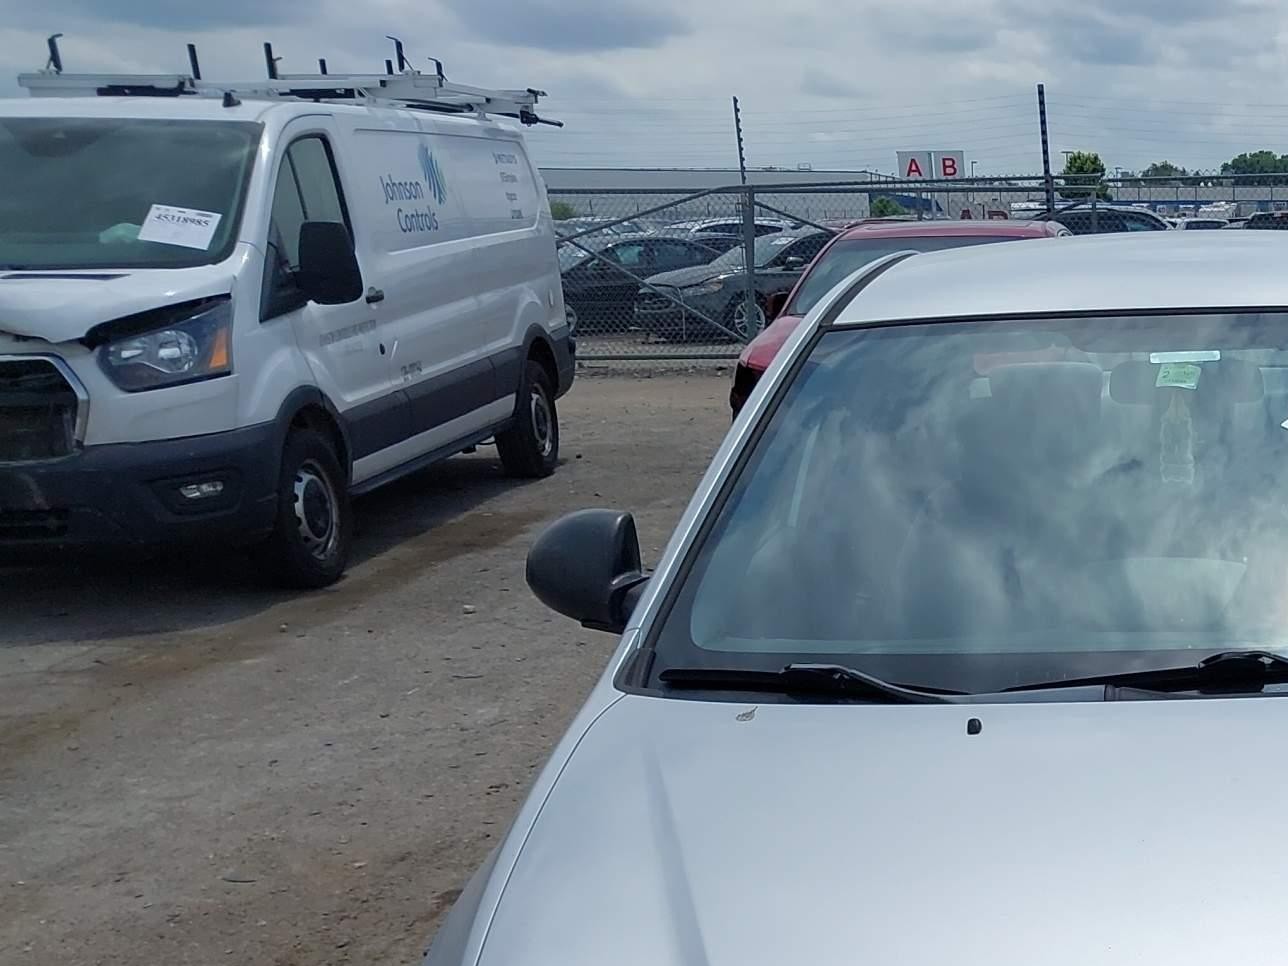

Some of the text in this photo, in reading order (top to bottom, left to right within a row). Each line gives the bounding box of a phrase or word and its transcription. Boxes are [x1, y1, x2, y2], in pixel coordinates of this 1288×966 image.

[906, 158, 922, 177] A
[942, 158, 957, 177] B
[380, 174, 424, 204] Johnson
[397, 205, 439, 233] Controls
